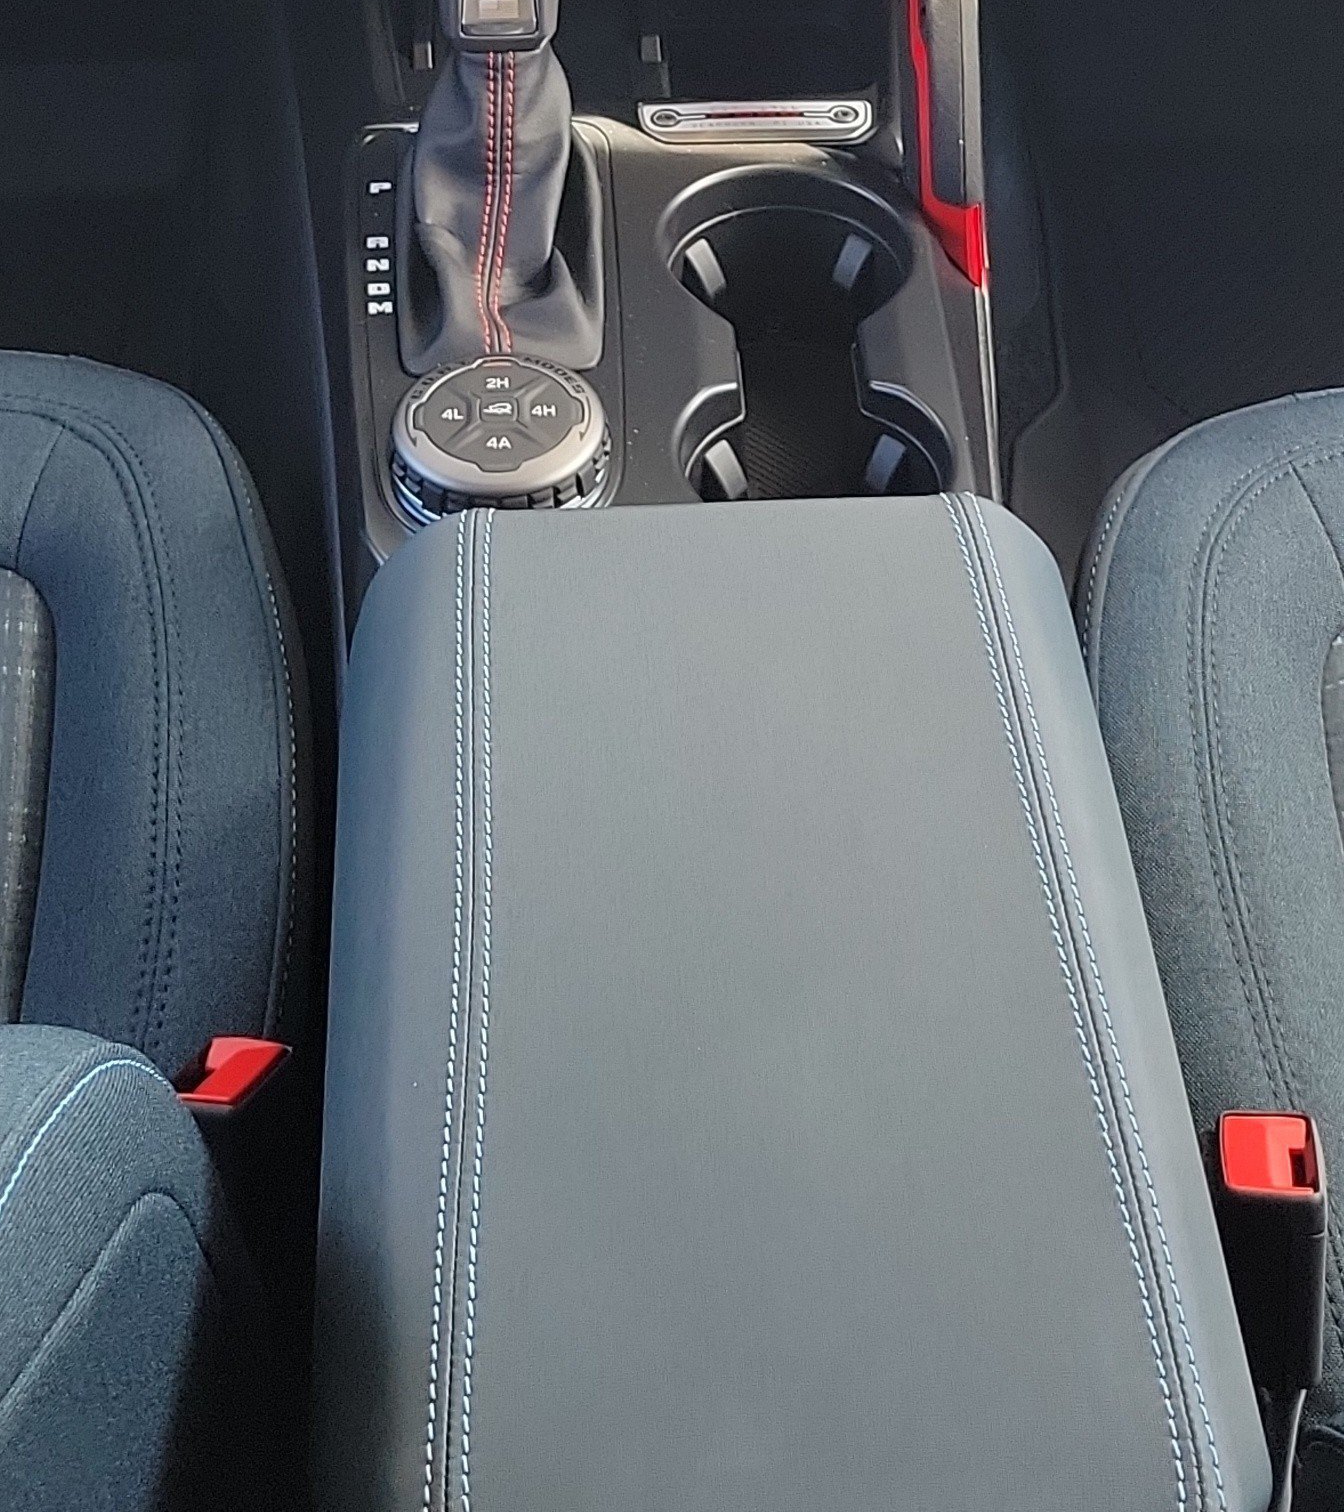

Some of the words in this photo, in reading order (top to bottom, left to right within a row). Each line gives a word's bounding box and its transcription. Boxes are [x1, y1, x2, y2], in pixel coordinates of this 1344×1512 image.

[366, 258, 390, 272] N
[367, 301, 393, 315] M
[485, 377, 510, 389] 2H
[441, 408, 465, 420] 4L
[531, 405, 556, 417] 4H
[486, 437, 511, 450] 4A
